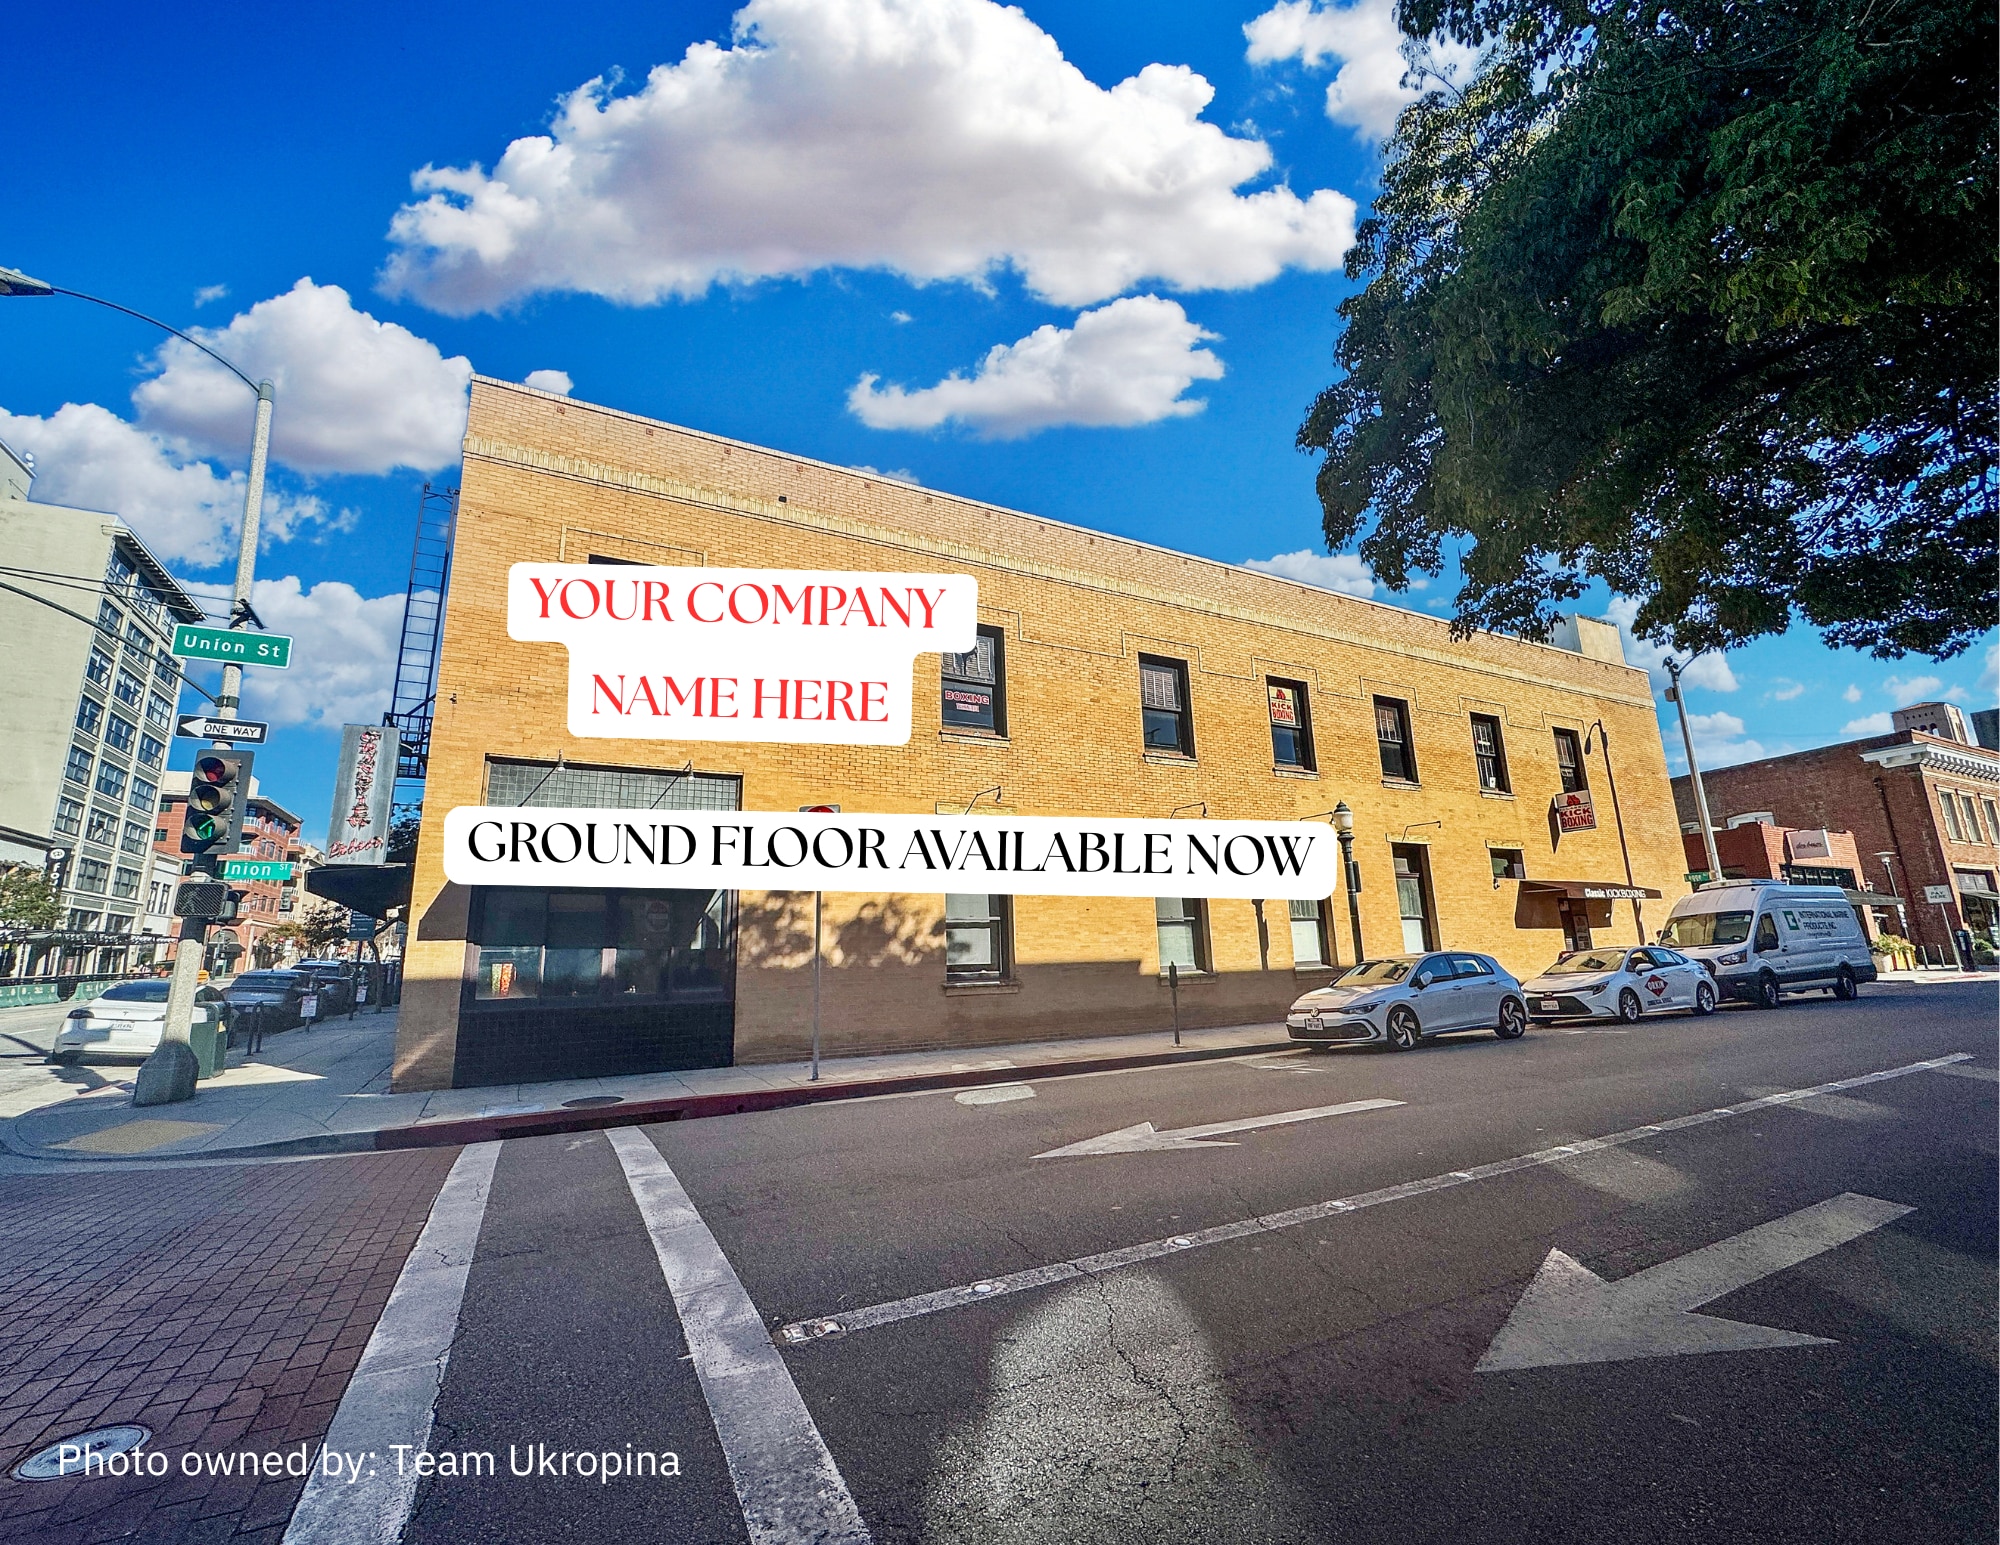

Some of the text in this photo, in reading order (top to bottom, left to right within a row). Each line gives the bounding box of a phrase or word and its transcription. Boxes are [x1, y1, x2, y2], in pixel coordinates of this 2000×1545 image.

[184, 635, 280, 658] Union St
[945, 690, 989, 705] BOXING
[1271, 702, 1293, 710] KICK
[204, 724, 257, 737] ONE WAY
[1560, 808, 1591, 818] KICK
[1561, 814, 1594, 828] BOXING
[218, 862, 271, 876] Union
[1648, 980, 1665, 990] ORKIN
